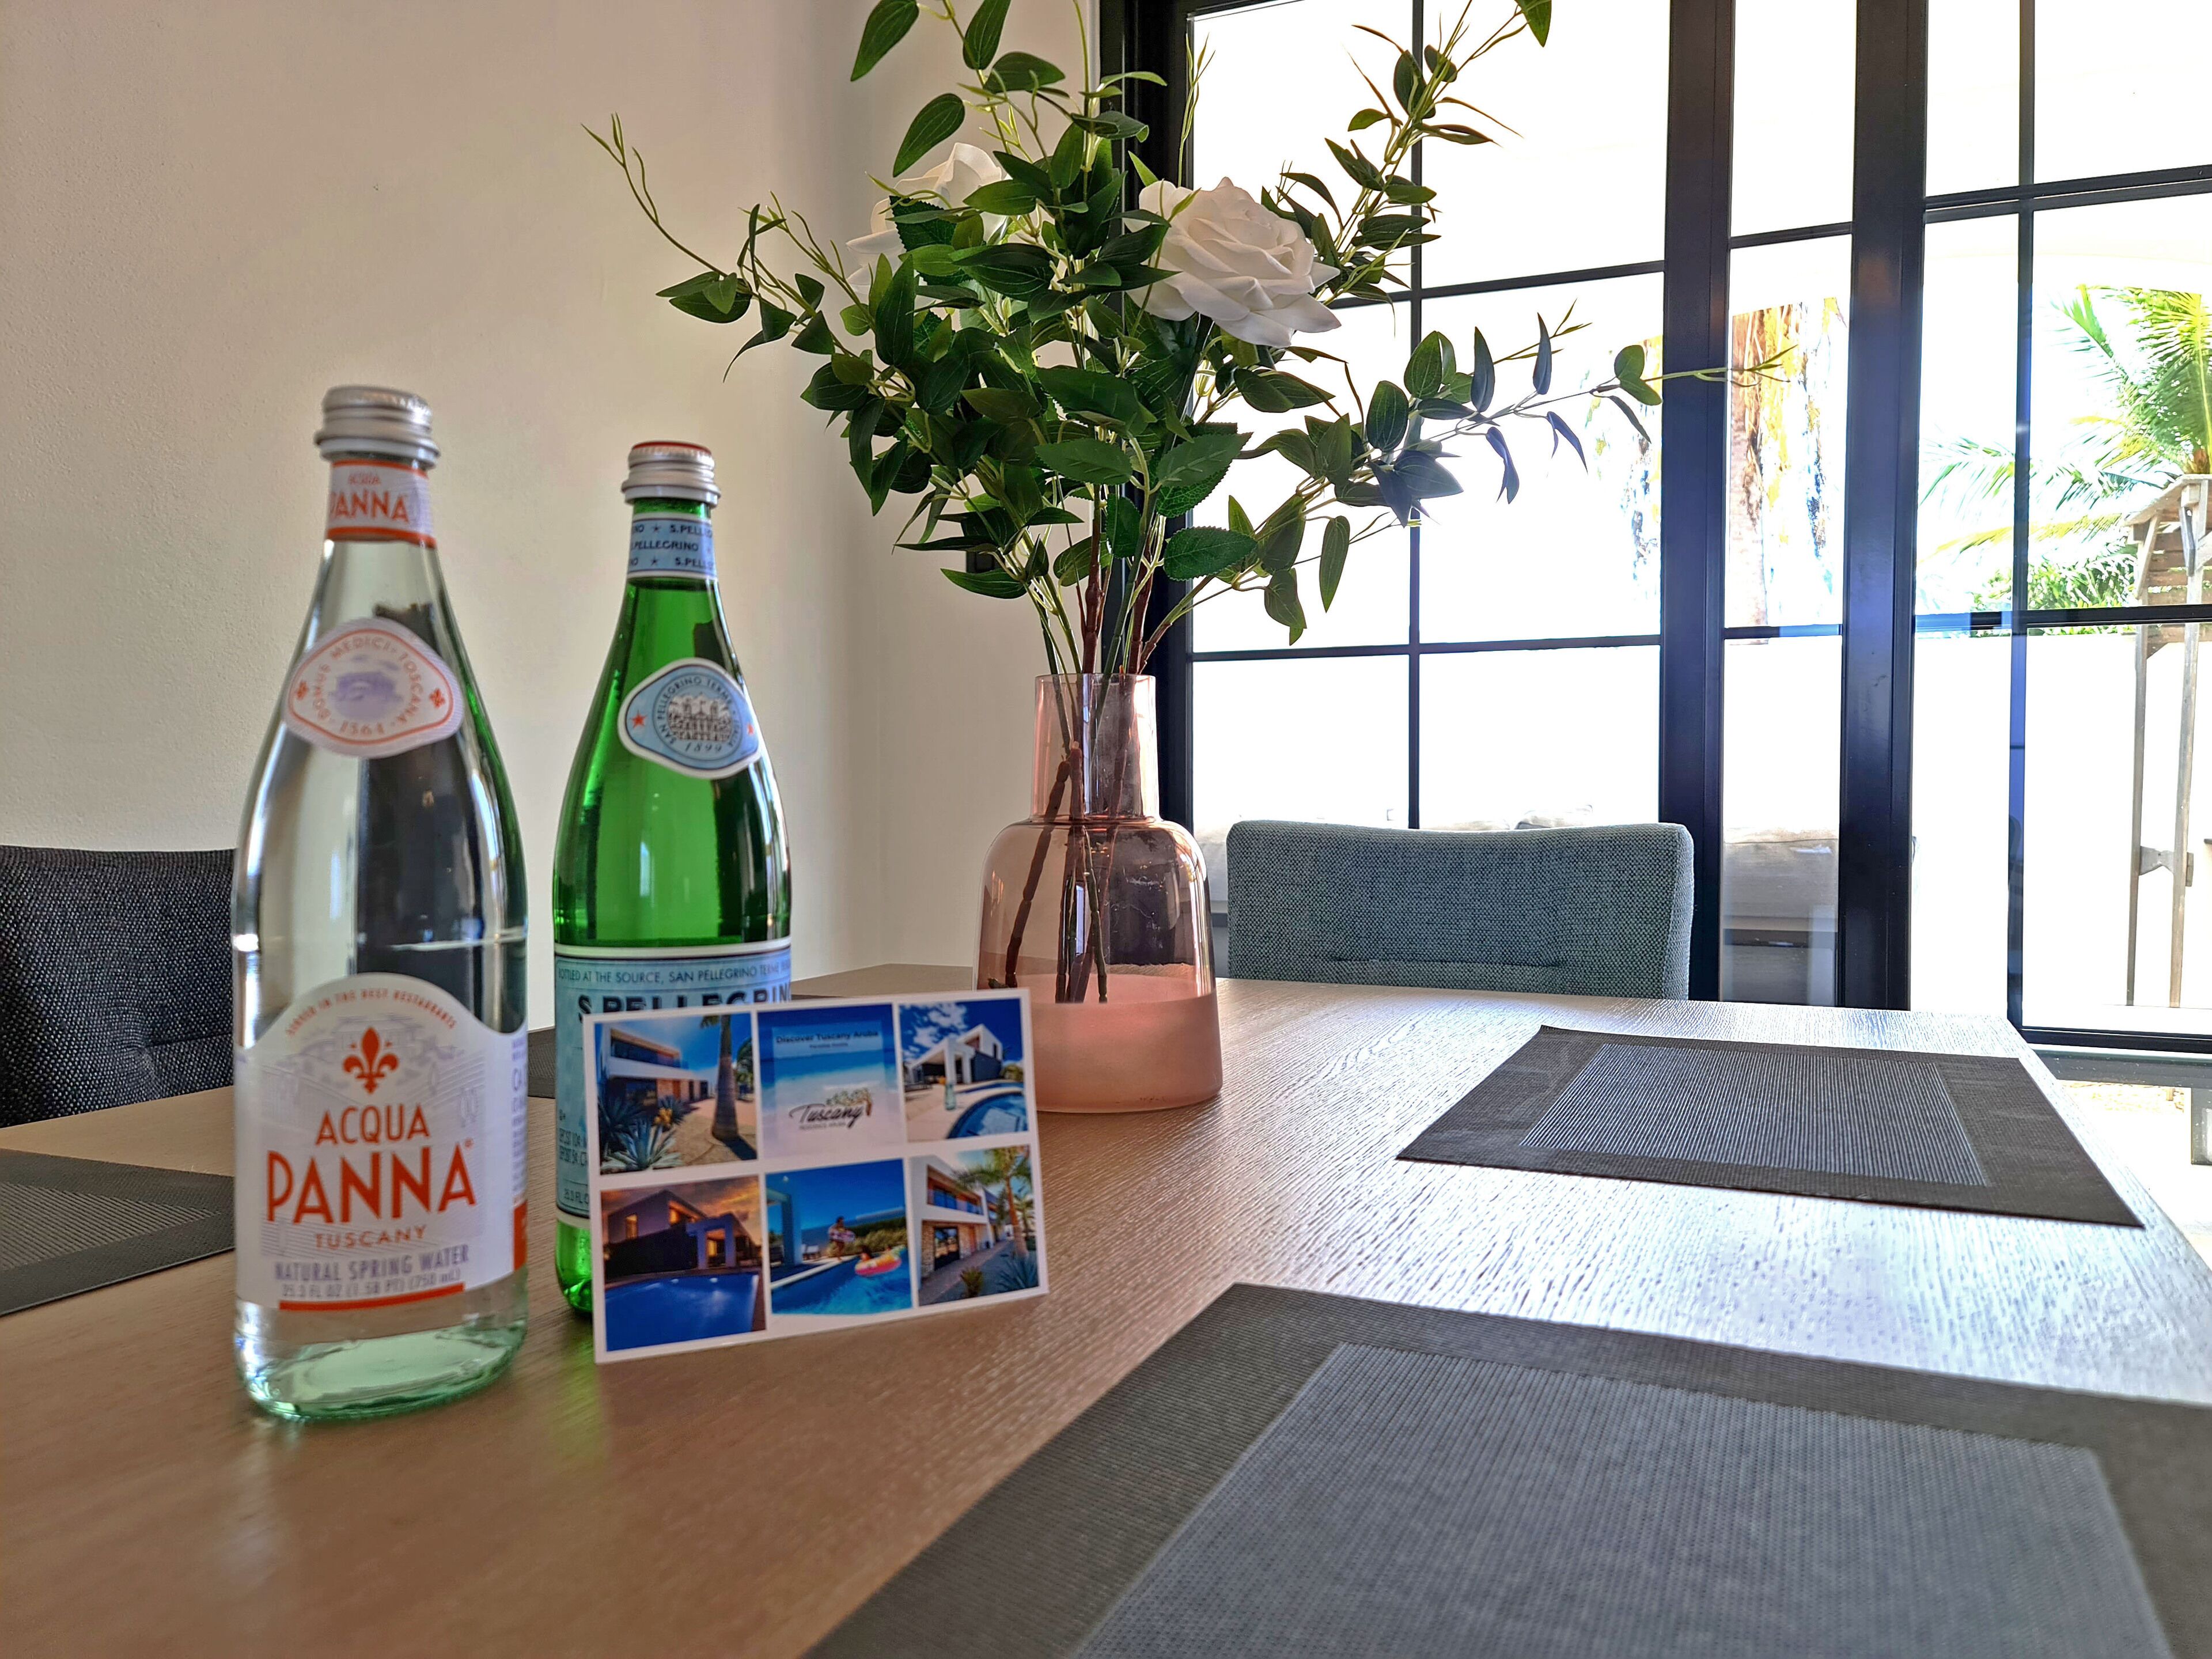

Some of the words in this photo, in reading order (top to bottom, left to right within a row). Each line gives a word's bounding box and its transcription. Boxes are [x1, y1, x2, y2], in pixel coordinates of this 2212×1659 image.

[657, 676, 702, 720] PELLEGRINO
[658, 724, 677, 744] SAN
[582, 971, 592, 981] AT
[595, 972, 611, 982] THE
[668, 971, 694, 983] SAN
[698, 965, 757, 981] PELLEGRINO
[775, 1035, 814, 1043] Discover
[816, 1032, 851, 1041] Tuscany
[853, 1029, 879, 1037] Aruba
[315, 1103, 430, 1146] ACQUA
[789, 1103, 864, 1128] Tuscany
[267, 1143, 476, 1225] PANNA
[315, 1225, 426, 1250] TUSCANY
[275, 1261, 342, 1281] NATURAL
[349, 1255, 412, 1281] SPRING
[419, 1244, 469, 1270] WATER
